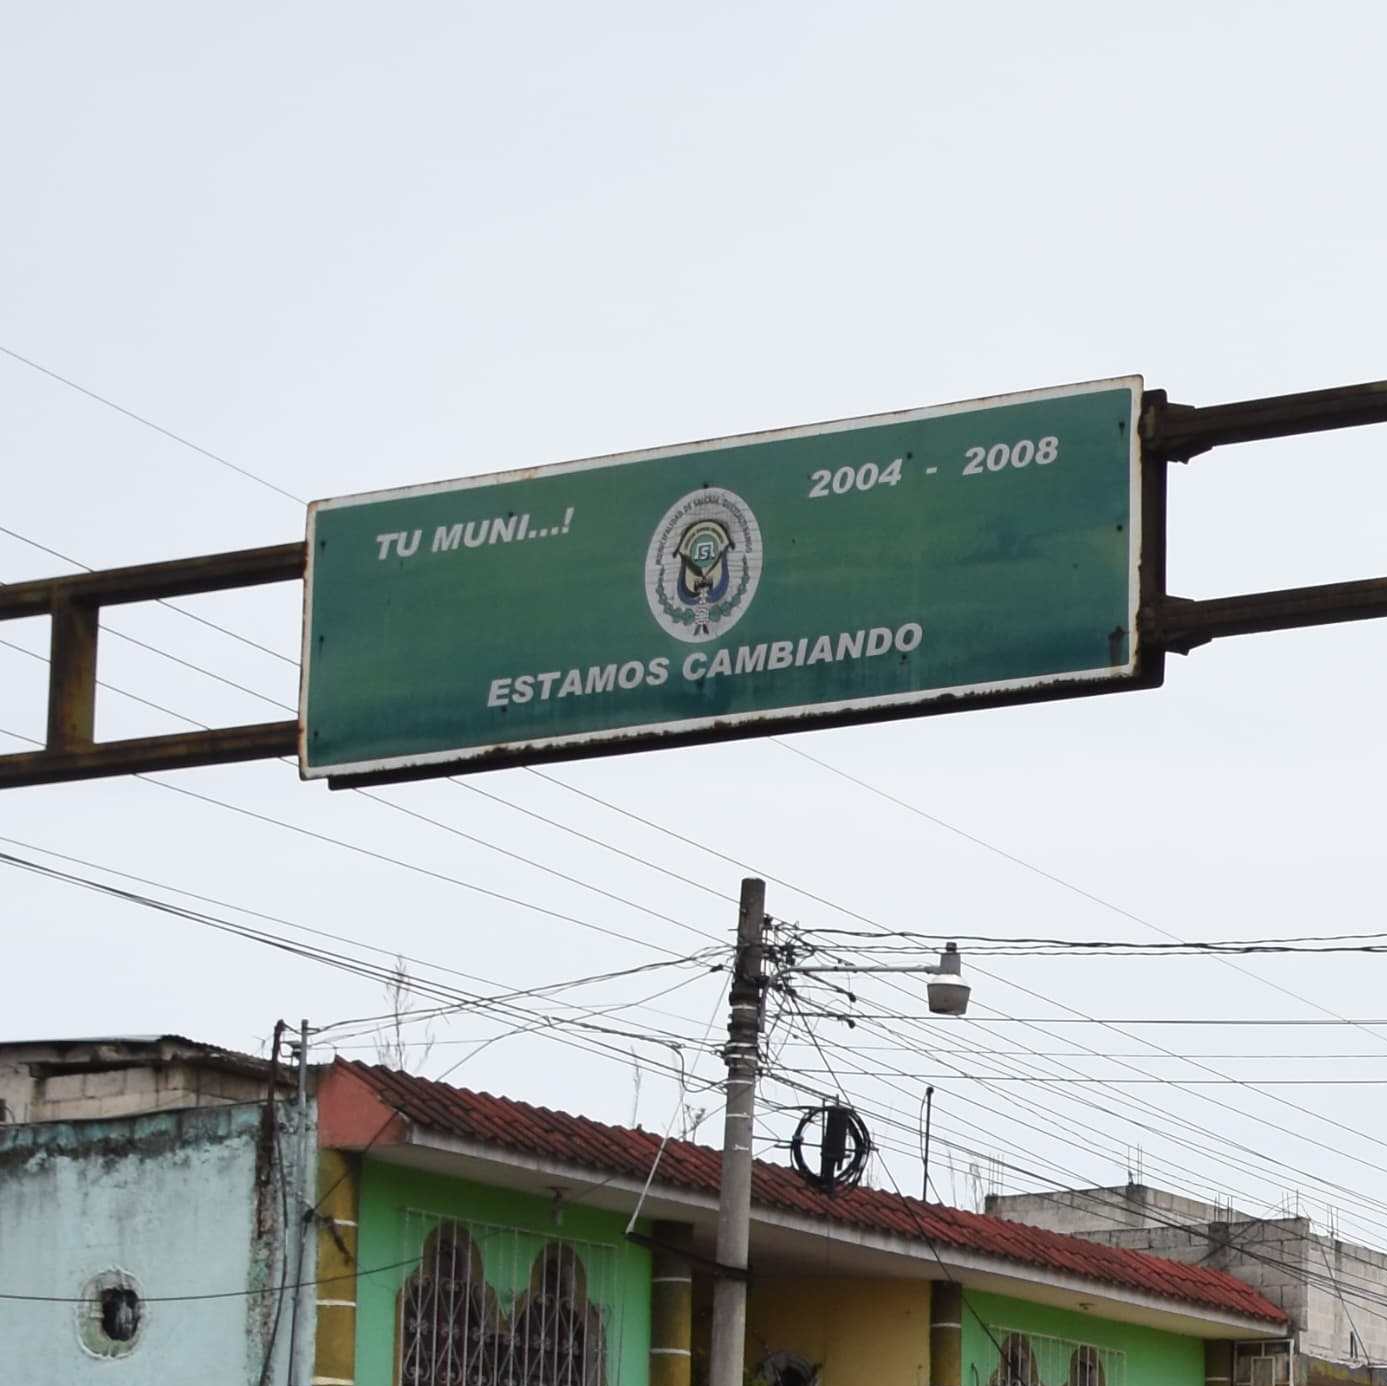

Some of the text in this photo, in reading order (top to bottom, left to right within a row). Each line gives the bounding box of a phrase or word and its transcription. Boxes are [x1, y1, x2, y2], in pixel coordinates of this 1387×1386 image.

[809, 458, 903, 498] 2004
[962, 436, 1059, 476] 2008
[376, 529, 422, 560] TU
[487, 622, 923, 706] ESTAMOS CAMBIANDO
